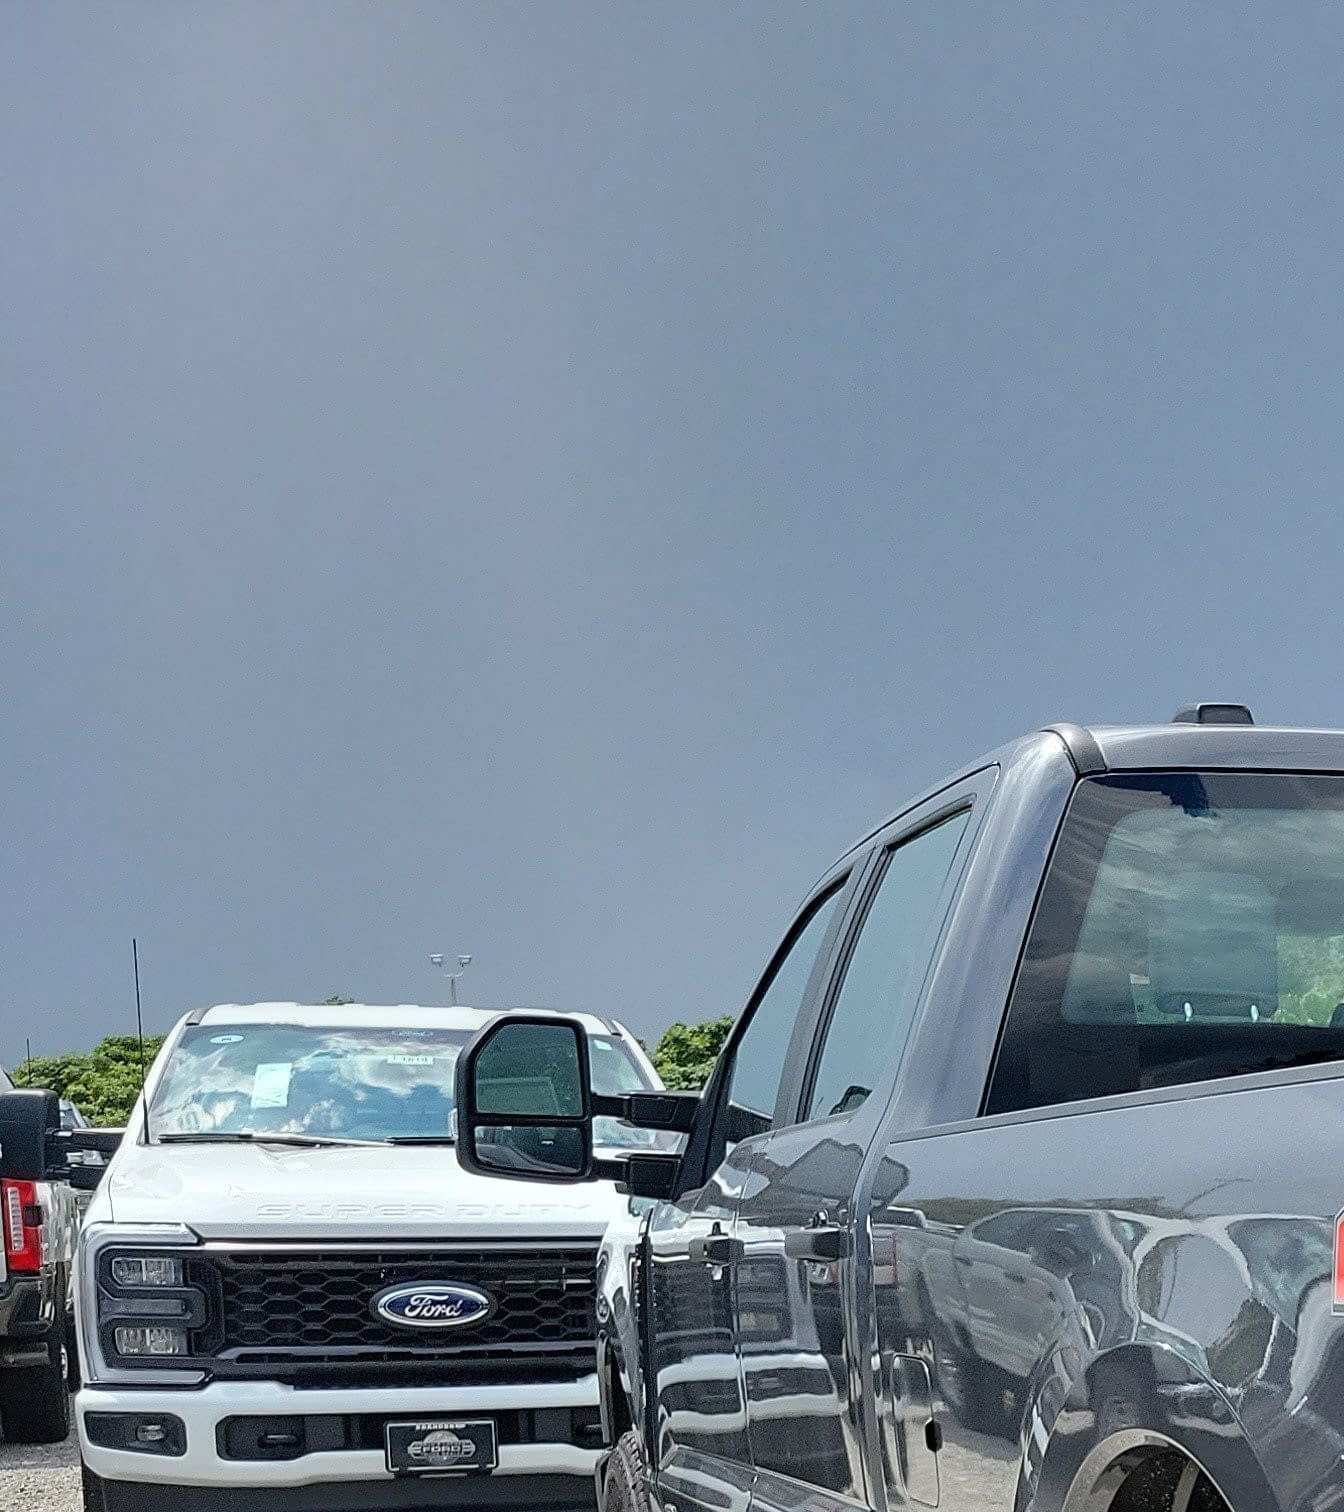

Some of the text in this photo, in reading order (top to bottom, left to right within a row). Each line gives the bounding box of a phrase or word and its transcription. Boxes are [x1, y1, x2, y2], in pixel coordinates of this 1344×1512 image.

[257, 1203, 592, 1219] SUPER DUTY
[404, 1293, 462, 1318] Ford
